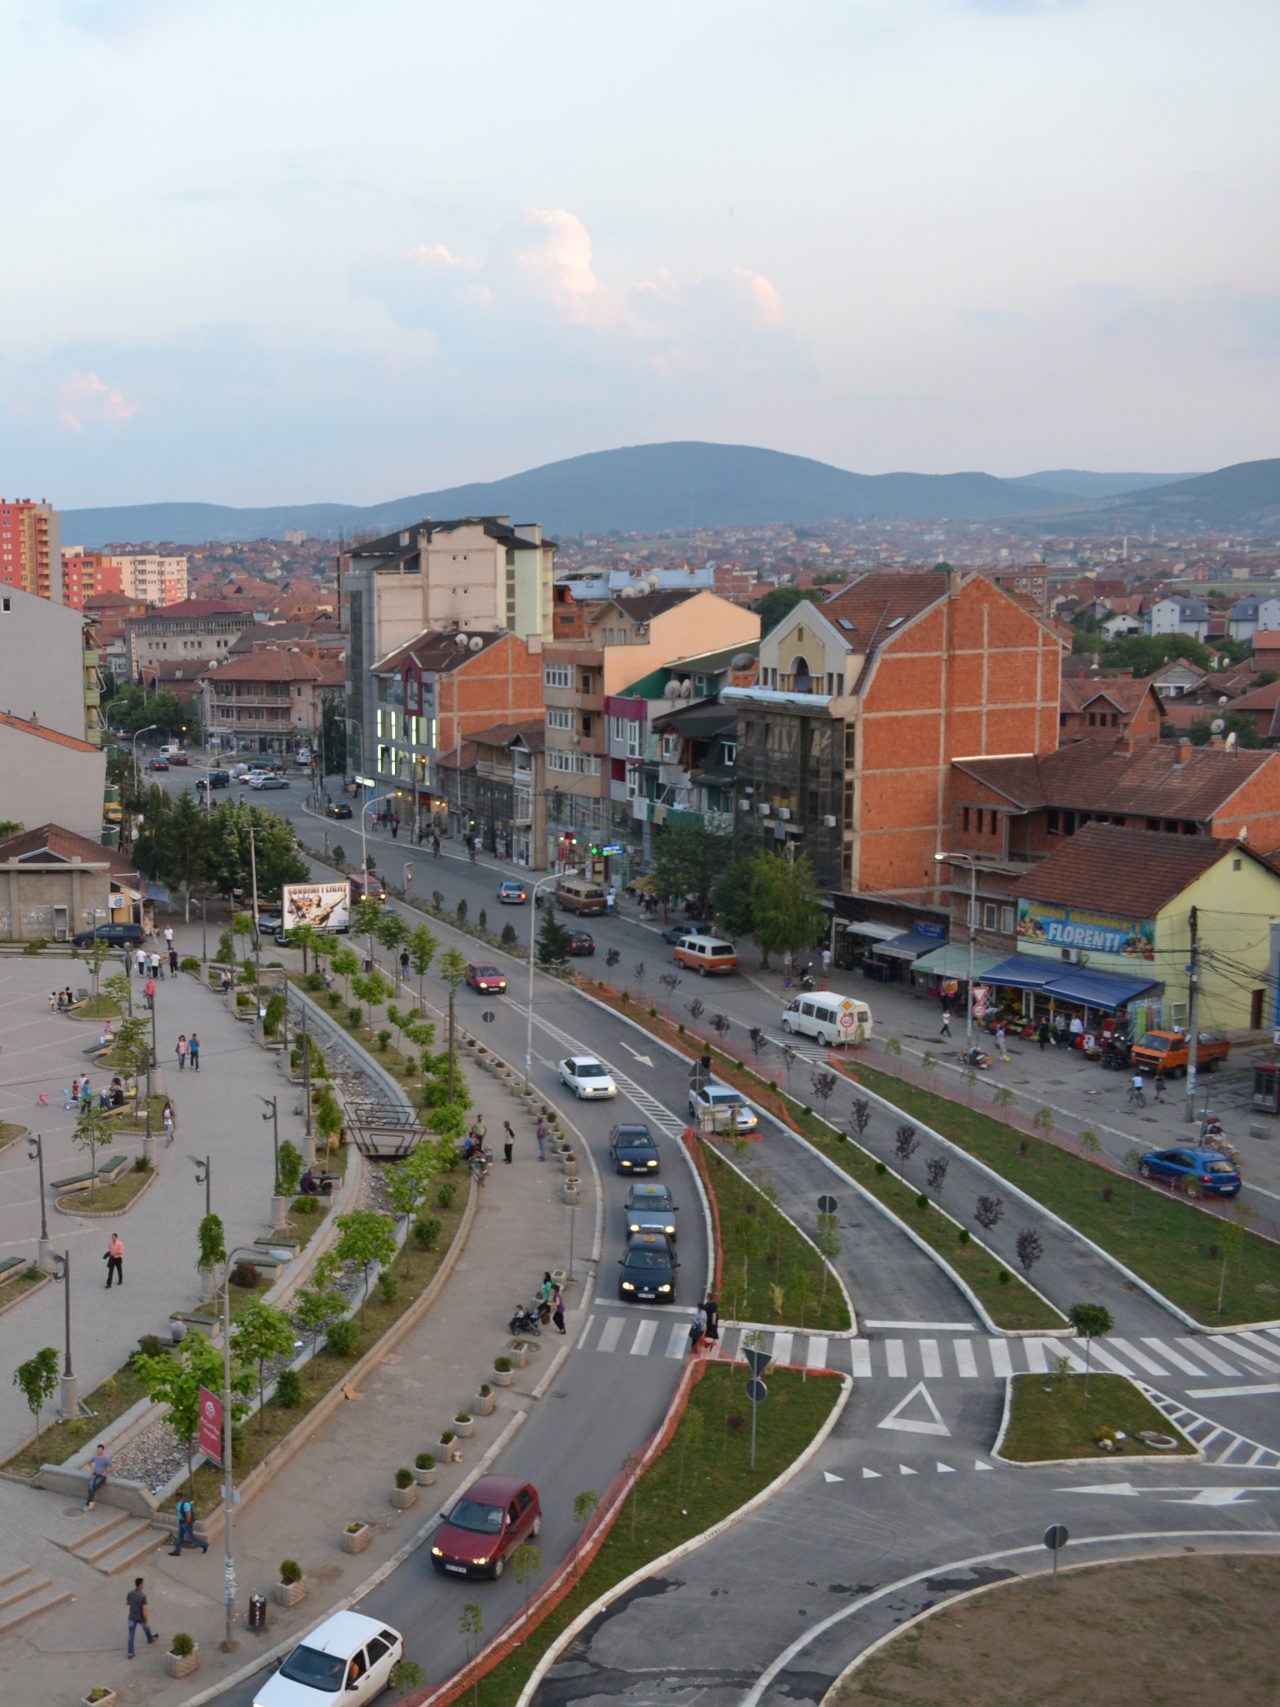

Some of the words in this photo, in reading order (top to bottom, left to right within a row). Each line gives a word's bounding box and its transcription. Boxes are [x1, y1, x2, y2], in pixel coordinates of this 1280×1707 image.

[1028, 902, 1066, 920] MINI
[1069, 910, 1142, 933] MARKET
[1047, 922, 1121, 951] FLORENTI
